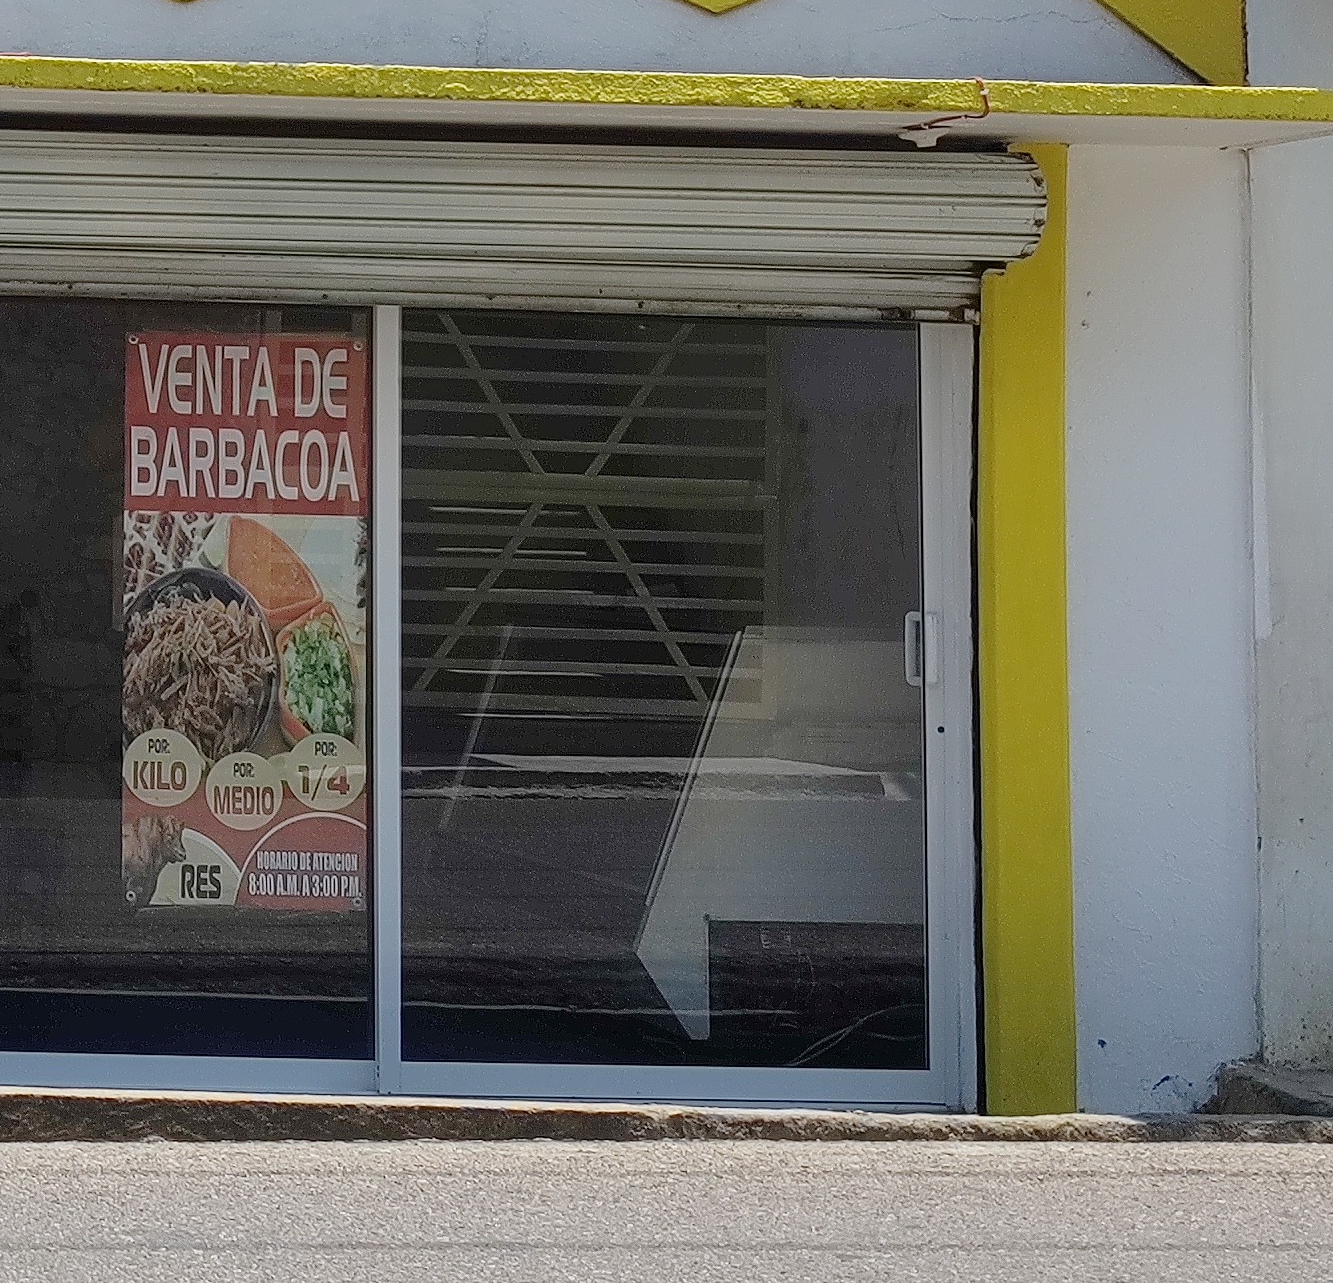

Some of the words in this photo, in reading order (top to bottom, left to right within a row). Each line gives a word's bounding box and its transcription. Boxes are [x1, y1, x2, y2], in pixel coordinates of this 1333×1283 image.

[138, 343, 279, 418] VENTA
[293, 346, 348, 419] DE
[129, 424, 360, 502] BARBACOA
[147, 738, 170, 754] POR:
[314, 740, 338, 757] POR:
[132, 760, 188, 791] KILO
[297, 763, 351, 802] 1/4
[212, 784, 275, 817] MEDIO
[256, 850, 299, 871] HORARIO
[299, 851, 312, 871] DE
[313, 852, 358, 872] ATENCION
[182, 864, 222, 900] RES
[248, 872, 275, 896] 8:00
[276, 873, 300, 896] A.M.
[302, 874, 311, 897] A
[312, 874, 339, 897] 3:00
[340, 875, 363, 898] P.M.
